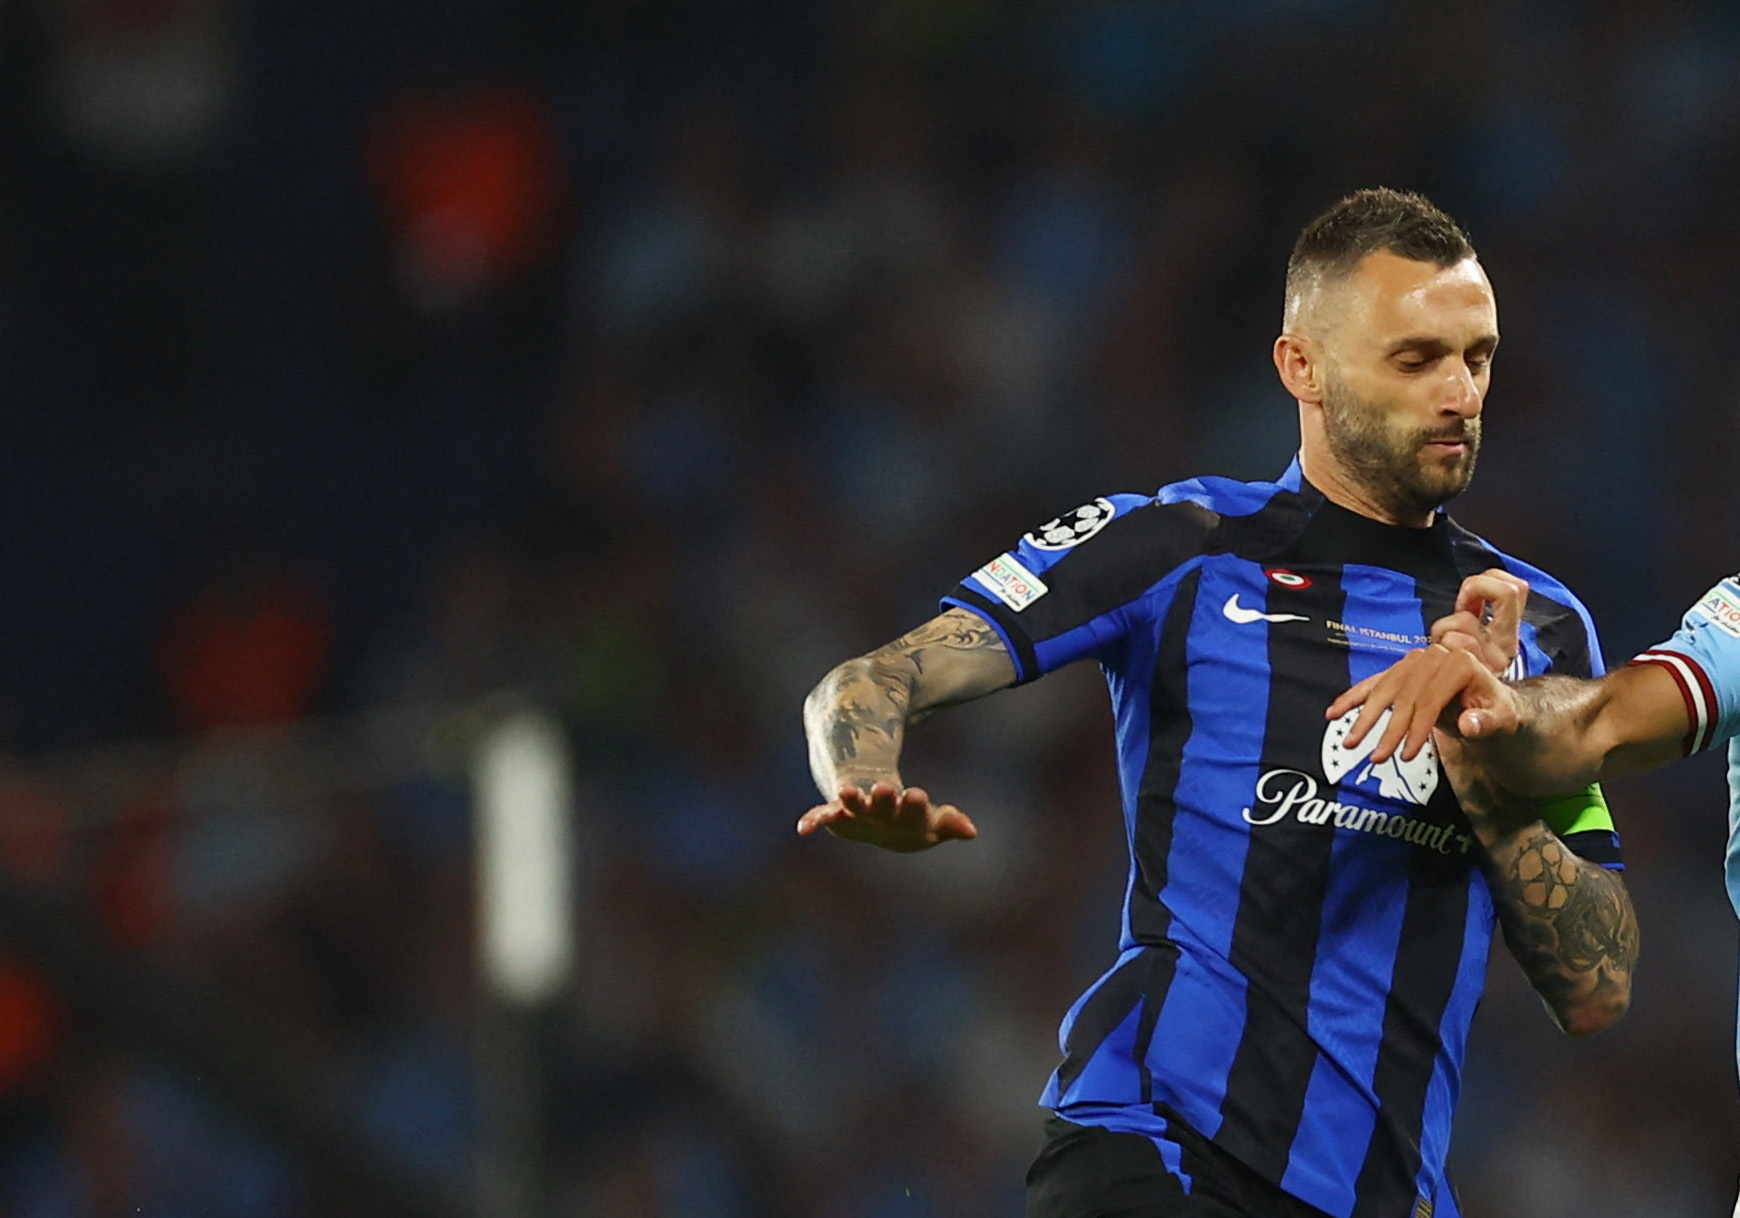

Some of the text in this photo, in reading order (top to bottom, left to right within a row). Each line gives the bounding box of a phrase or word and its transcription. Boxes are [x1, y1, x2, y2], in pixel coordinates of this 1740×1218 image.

[1326, 620, 1356, 633] FINAL
[1359, 627, 1411, 644] ISTANBUL
[1242, 768, 1474, 855] Paramount+
